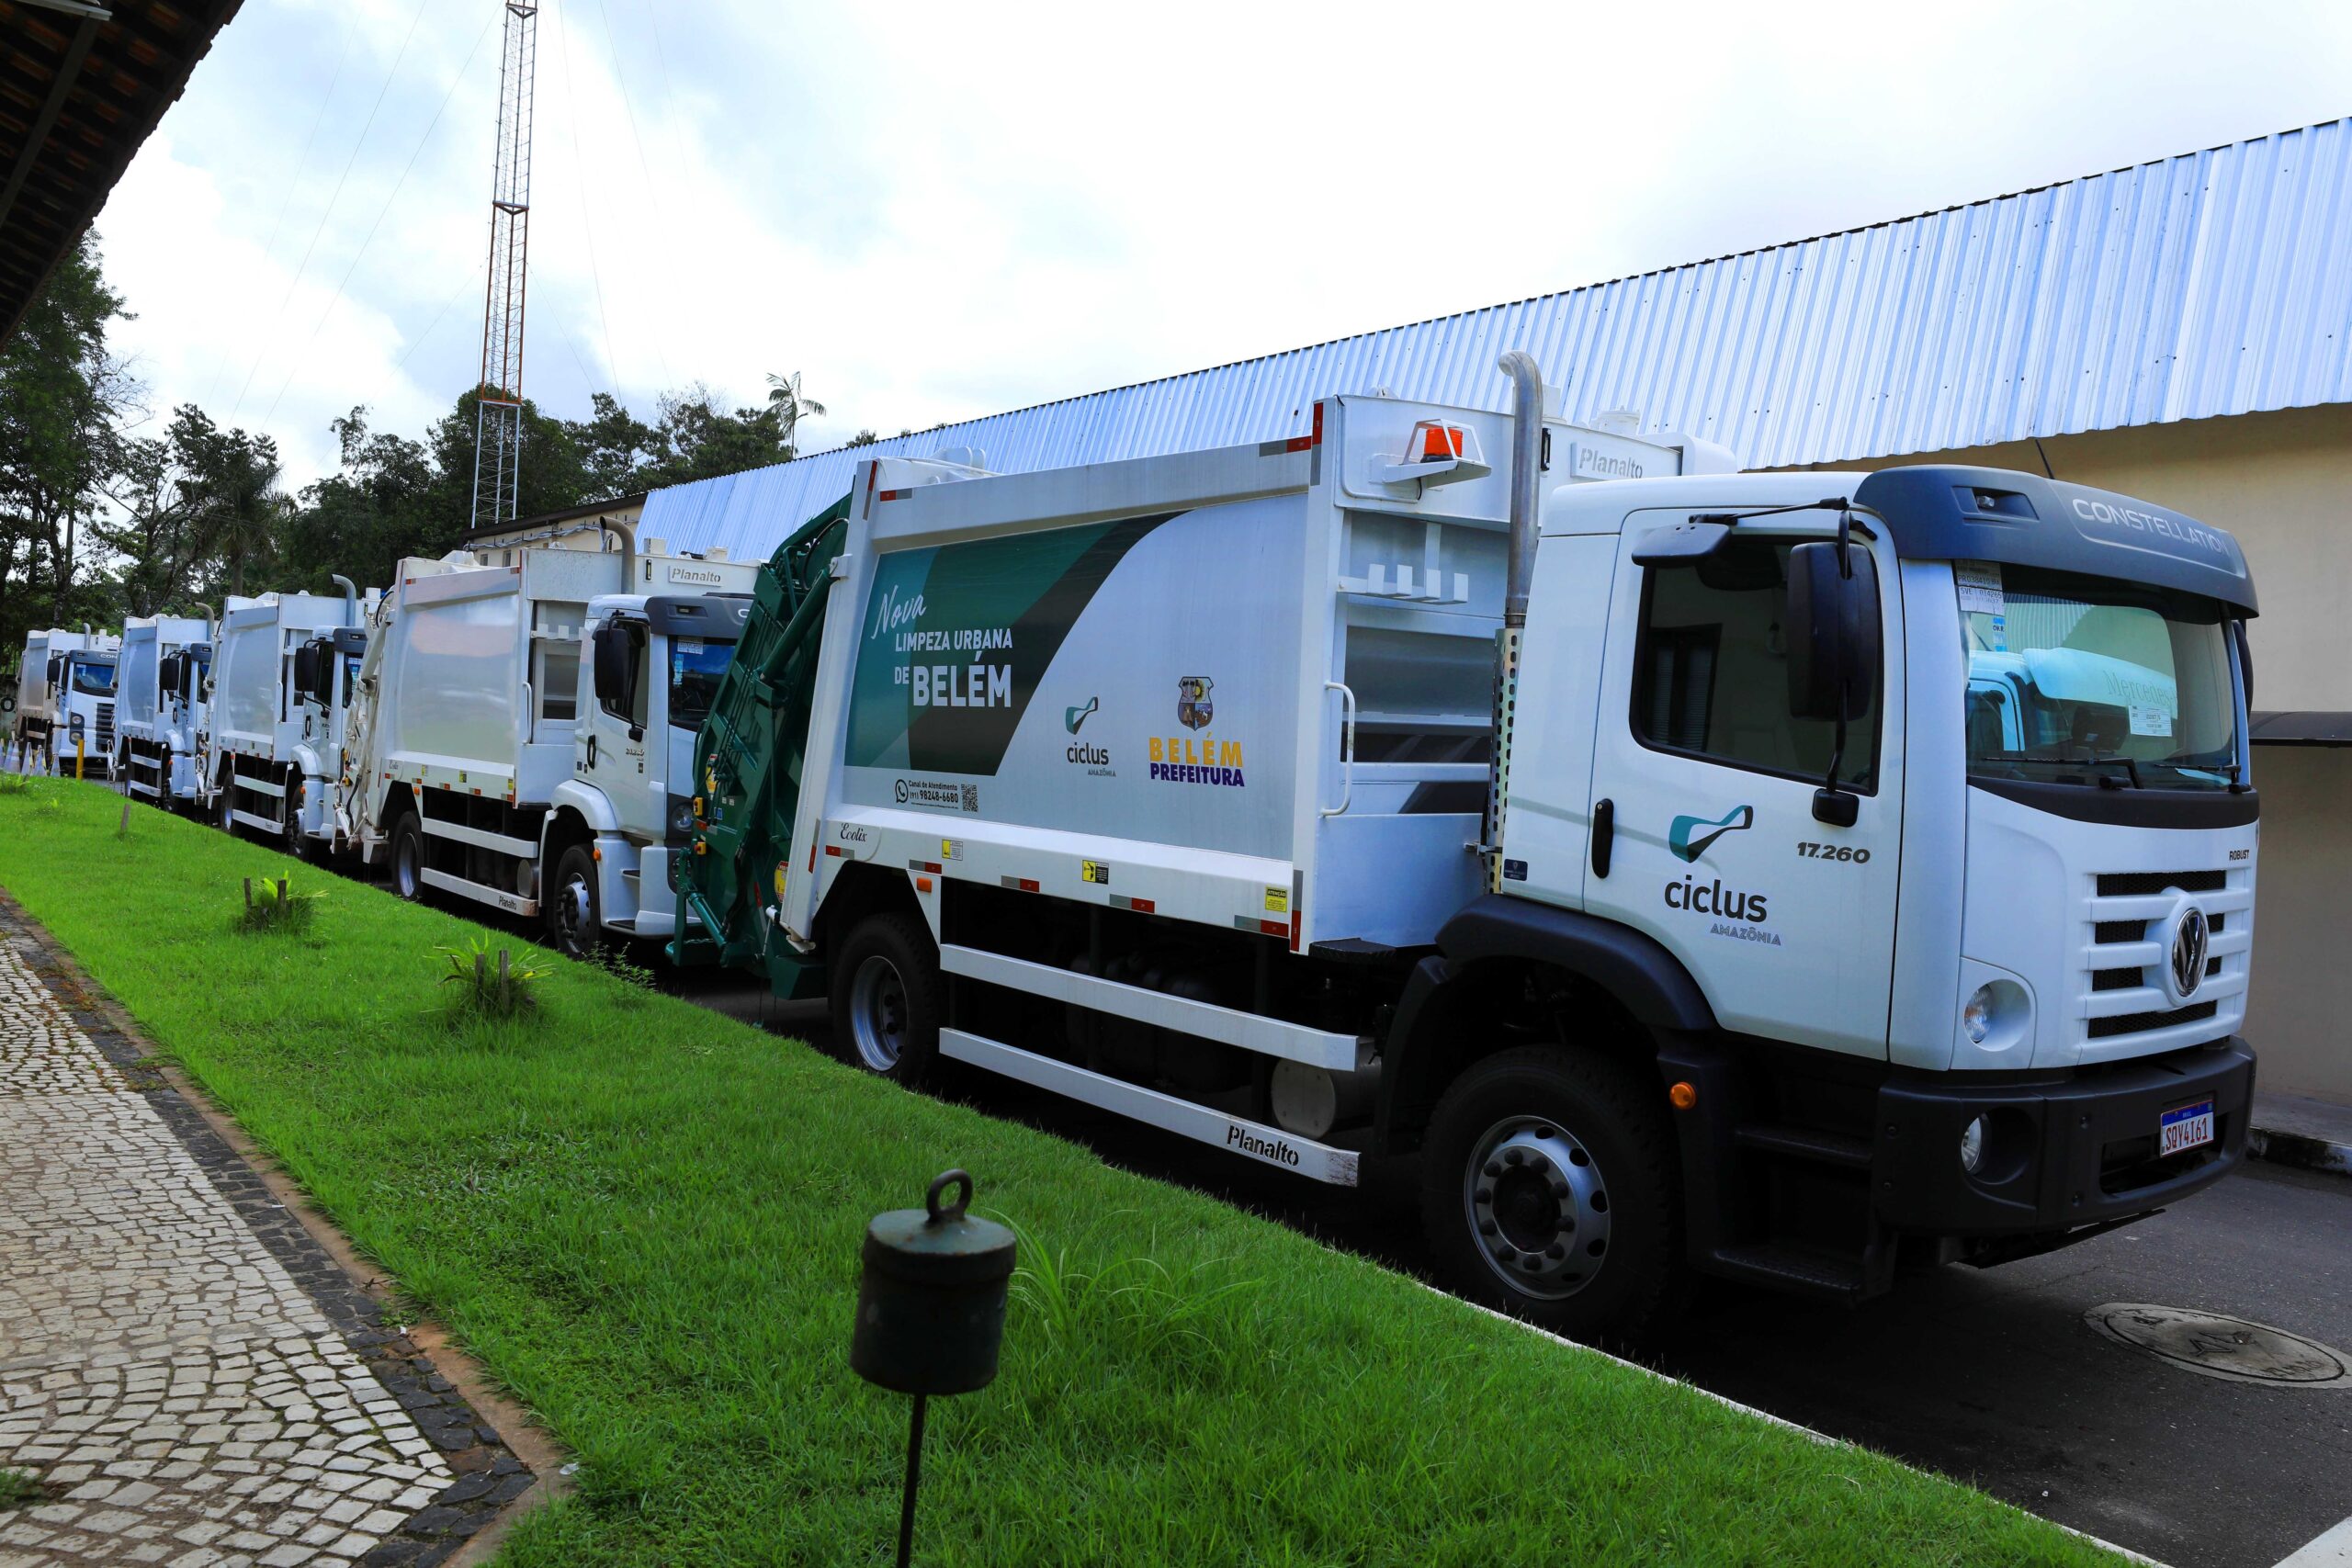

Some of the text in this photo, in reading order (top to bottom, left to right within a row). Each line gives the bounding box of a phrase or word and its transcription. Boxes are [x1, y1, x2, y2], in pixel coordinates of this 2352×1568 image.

[1579, 447, 1643, 479] Planalto
[2073, 499, 2229, 557] CONSTELLATION
[672, 568, 721, 582] Planalto
[871, 584, 927, 639] Nova
[895, 628, 1013, 652] LIMPEZA URBANA
[894, 650, 1012, 707] DE BELÉM
[1067, 742, 1109, 765] ciclus
[1149, 731, 1244, 768] BELÉM
[909, 780, 921, 788] Canal
[929, 782, 958, 791] Atendimento
[1150, 762, 1245, 787] PREFEITURA
[920, 790, 959, 803] 98248-6680
[841, 822, 867, 841] Ecolix
[1797, 841, 1871, 863] 17.260
[2229, 849, 2250, 862] ROBUST
[1664, 874, 1768, 923] ciclus
[1710, 922, 1781, 946] AMAZÔNIA
[1227, 1124, 1299, 1167] Planalto
[2165, 1117, 2208, 1151] SQY4I61
